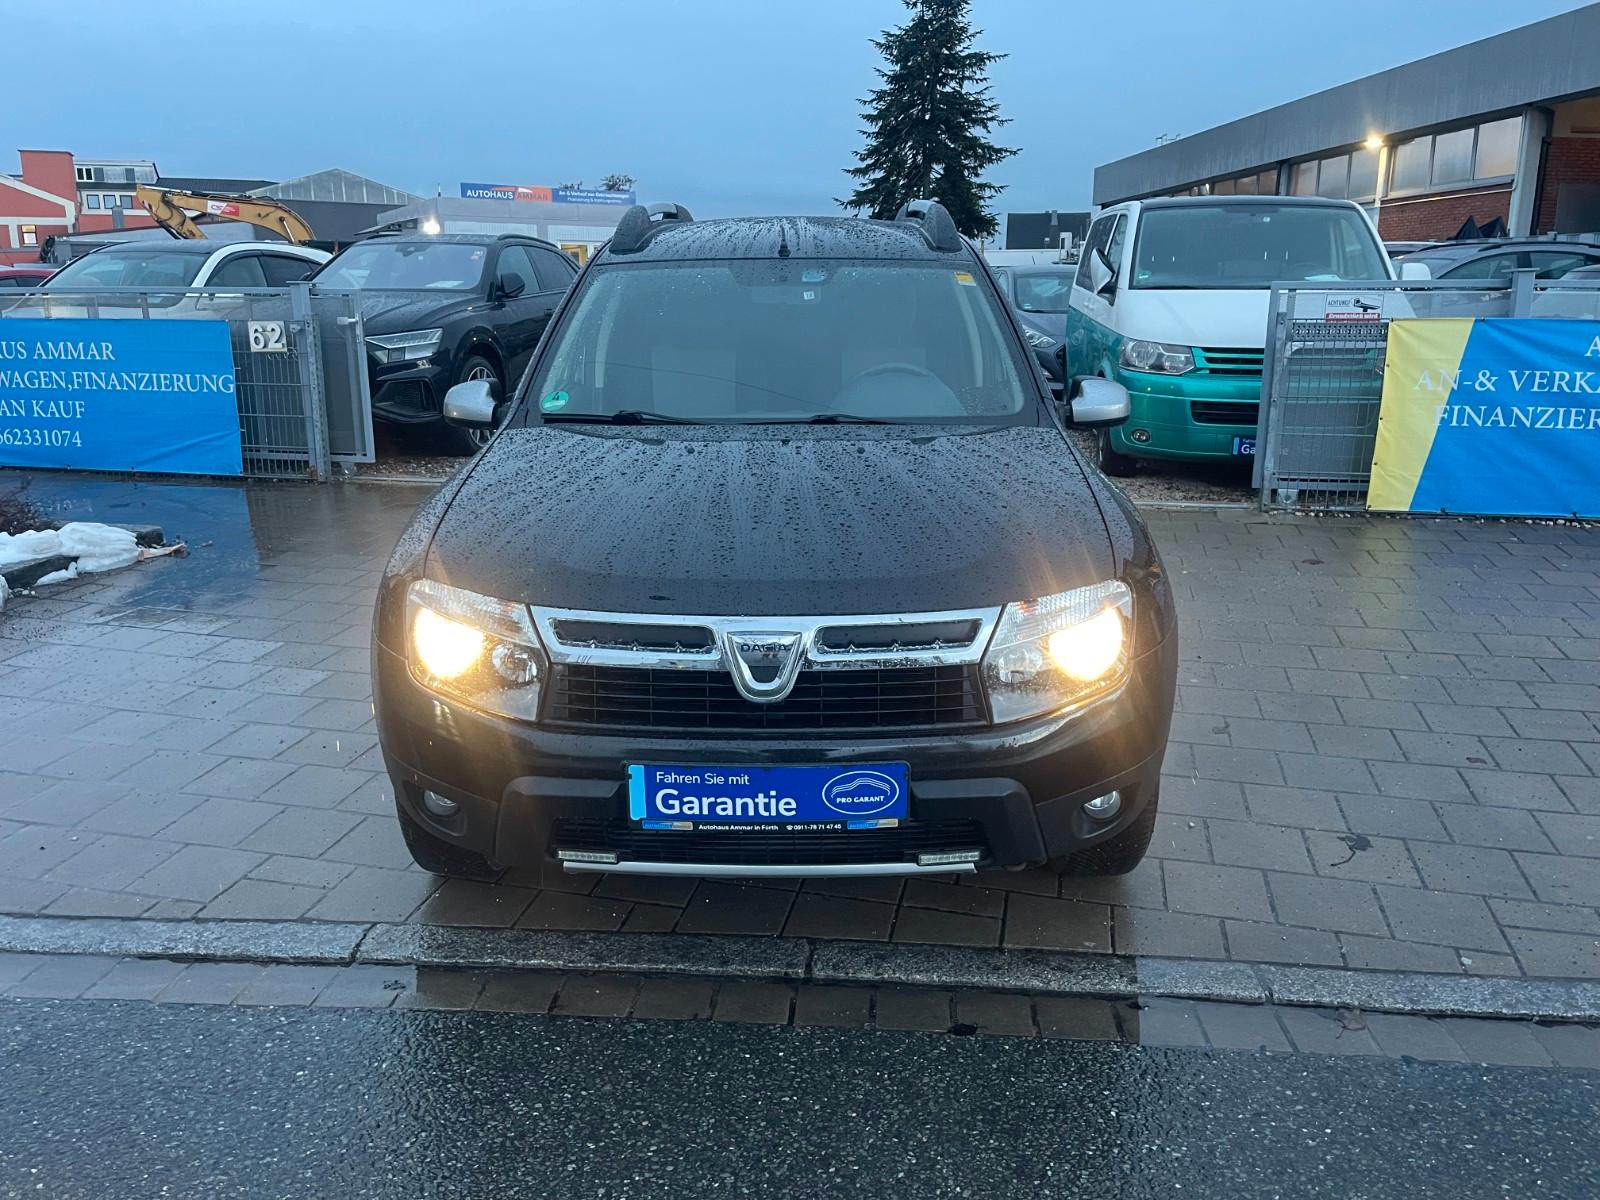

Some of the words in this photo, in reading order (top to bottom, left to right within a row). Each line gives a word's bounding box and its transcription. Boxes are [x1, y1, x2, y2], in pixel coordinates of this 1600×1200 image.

[466, 189, 514, 200] AUTOHAUS
[253, 323, 284, 350] 62
[0, 341, 27, 360] US
[33, 341, 116, 361] AMMAR
[31, 400, 85, 418] KAUF
[740, 643, 788, 653] DACIA
[656, 771, 701, 784] Fahren
[704, 772, 725, 785] Sie
[728, 773, 750, 785] mit
[655, 788, 797, 817] Garantie
[853, 795, 885, 803] GARANT
